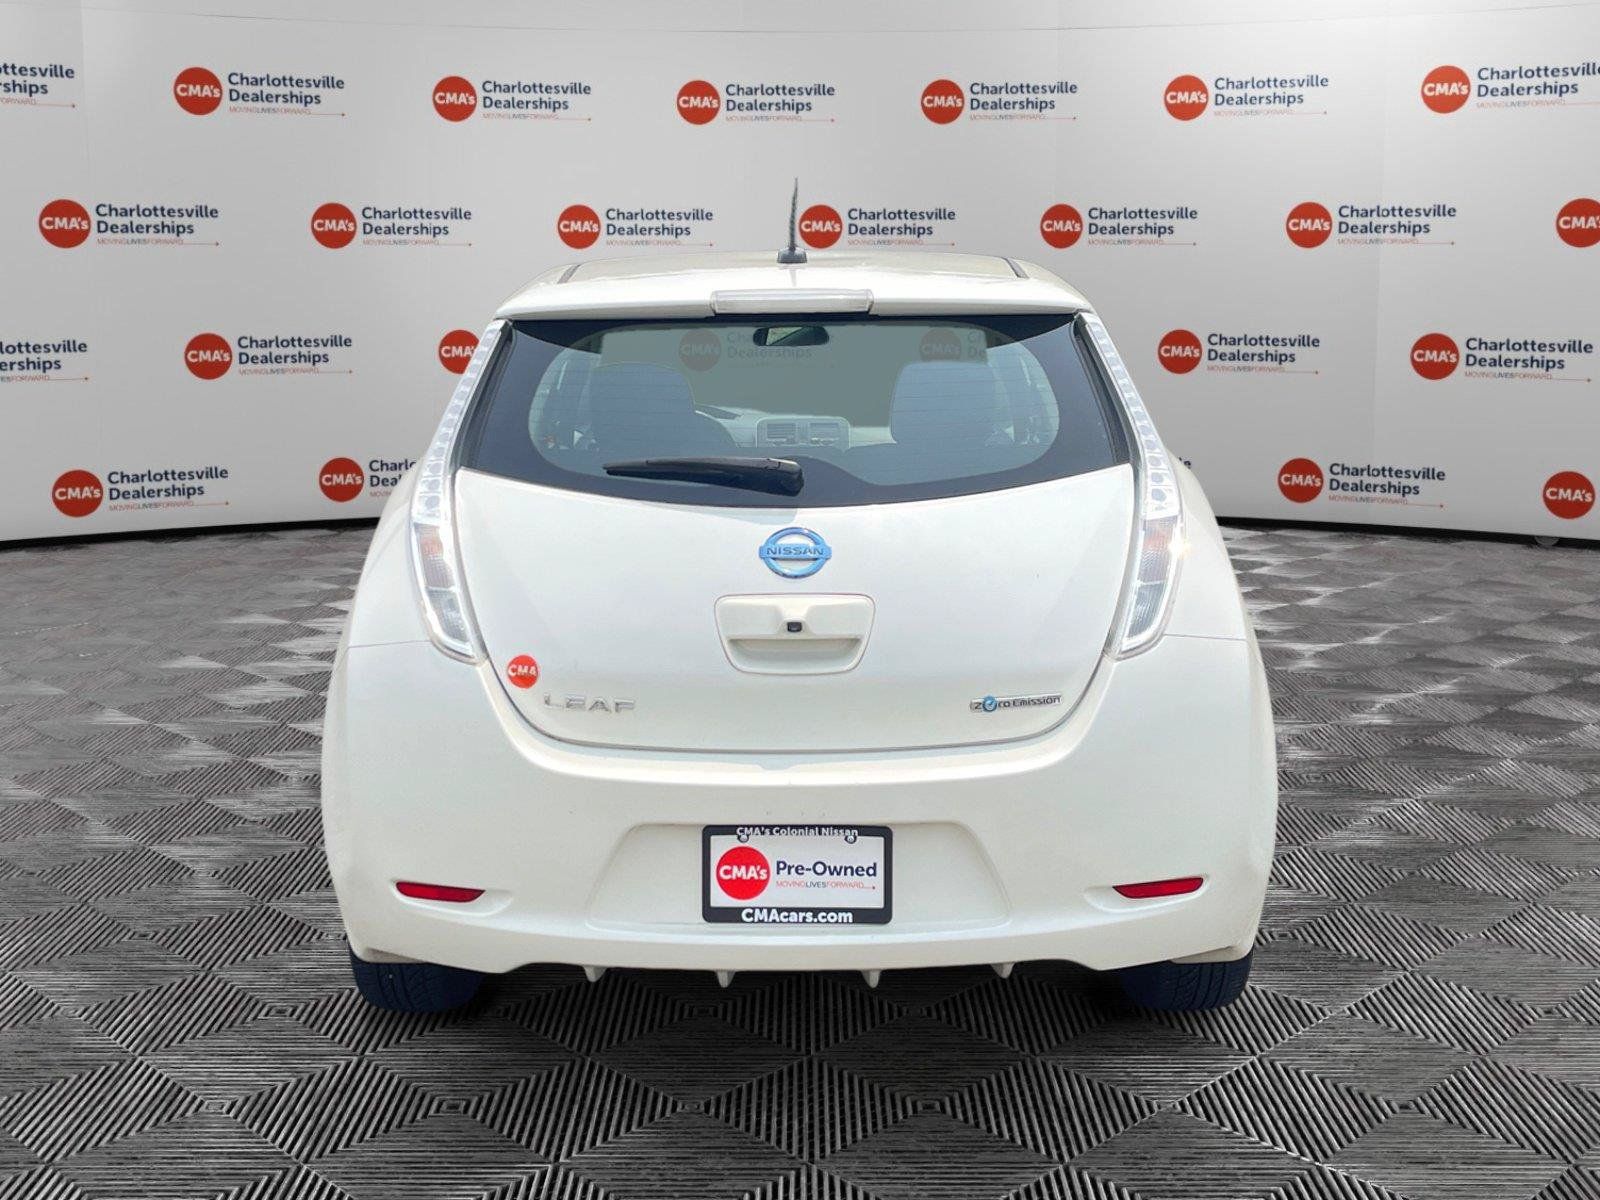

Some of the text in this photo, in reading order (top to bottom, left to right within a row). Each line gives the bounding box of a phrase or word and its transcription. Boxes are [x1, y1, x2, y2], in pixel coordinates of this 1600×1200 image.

[228, 72, 344, 89] Charlottesville
[1214, 75, 1329, 90] Charlottesville
[177, 84, 221, 98] CMA's
[482, 81, 591, 95] Charlottesville
[725, 83, 835, 96] Charlottesville
[970, 82, 1077, 94] Charlottesville
[1424, 83, 1469, 96] CMA's
[1477, 82, 1579, 98] Dealerships
[229, 89, 321, 106] Dealerships
[434, 92, 476, 105] CMA's
[679, 96, 719, 108] CMA's
[923, 96, 963, 108] CMA's
[1166, 90, 1207, 103] CMA's
[1215, 92, 1304, 106] Dealerships
[482, 97, 569, 111] Dealerships
[725, 99, 812, 112] Dealerships
[971, 98, 1055, 110] Dealerships
[96, 204, 218, 219] Charlottesville
[361, 207, 472, 220] Charlottesville
[606, 209, 713, 221] Charlottesville
[848, 209, 956, 220] Charlottesville
[1088, 207, 1197, 220] Charlottesville
[1338, 205, 1457, 218] Charlottesville
[42, 217, 89, 230] CMA's
[97, 220, 194, 236] Dealerships
[314, 220, 354, 231] CMA's
[560, 221, 599, 232] CMA's
[801, 221, 841, 232] CMA's
[1043, 220, 1081, 231] CMA's
[1088, 222, 1174, 236] Dealerships
[1288, 219, 1330, 231] CMA's
[1338, 220, 1430, 236] Dealerships
[1559, 216, 1600, 229] CMA'
[362, 222, 449, 237] Dealerships
[607, 224, 691, 237] Dealerships
[848, 223, 933, 237] Dealerships
[238, 335, 352, 349] Charlottesville
[1208, 333, 1320, 347] Charlottesville
[1465, 338, 1593, 354] Charlottesville
[187, 351, 231, 363] CMA's
[238, 351, 329, 365] Dealerships
[441, 345, 474, 358] CMA'
[1160, 346, 1200, 358] CMA's
[1208, 349, 1296, 364] Dealerships
[1413, 350, 1457, 363] CMA's
[1466, 354, 1565, 370] Dealerships
[108, 467, 229, 485] Charlottesville
[1329, 463, 1445, 480] Charlottesville
[322, 473, 362, 486] CMA's
[1280, 474, 1321, 487] CMA's
[55, 487, 100, 500] CMA's
[109, 484, 205, 500] Dealerships
[1329, 479, 1420, 495] Dealerships
[1546, 487, 1592, 502] CMA's
[766, 546, 824, 556] NISSAN
[544, 693, 635, 713] LEAF
[773, 828, 819, 836] Colonial
[821, 828, 858, 837] Nissan
[719, 864, 768, 880] CMA's
[776, 861, 877, 877] Pre-Owned
[741, 909, 853, 923] CMAcars.com
